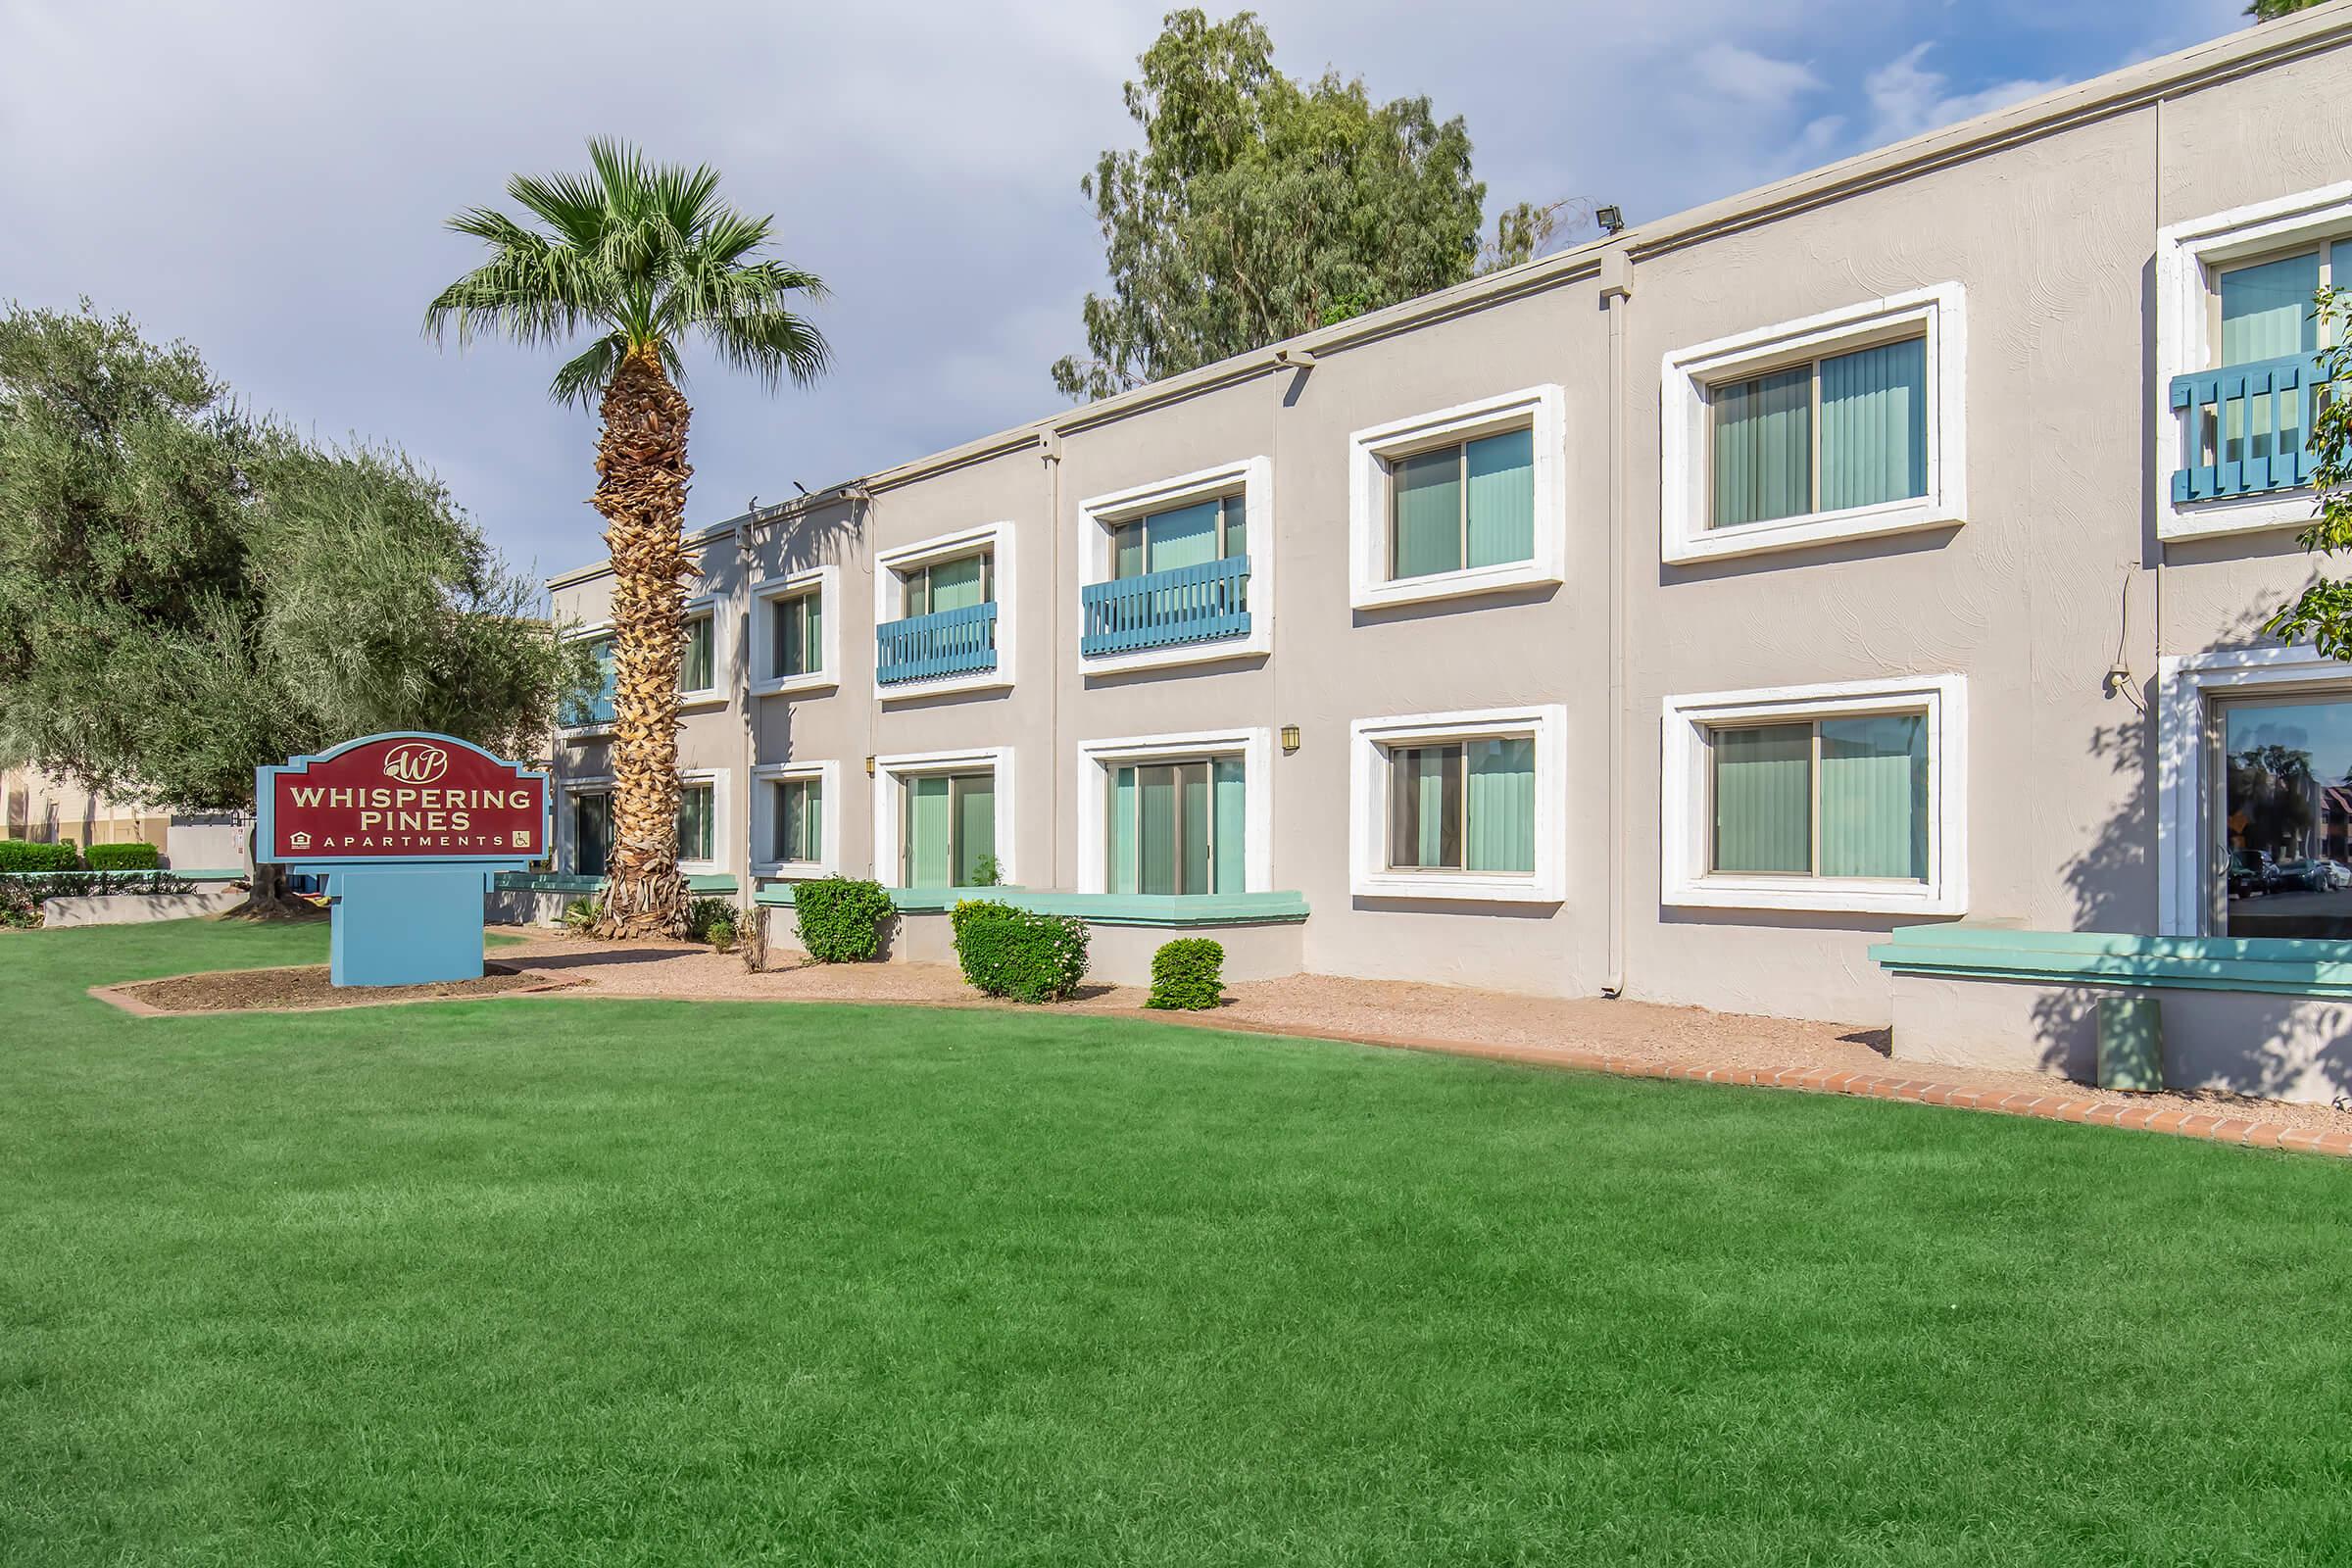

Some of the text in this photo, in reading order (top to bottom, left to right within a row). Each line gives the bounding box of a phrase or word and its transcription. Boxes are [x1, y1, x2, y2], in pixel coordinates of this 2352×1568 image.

[394, 749, 448, 781] WP
[290, 787, 530, 809] WHISPERING
[361, 810, 470, 831] PINES
[323, 836, 503, 847] APARTMENTS
